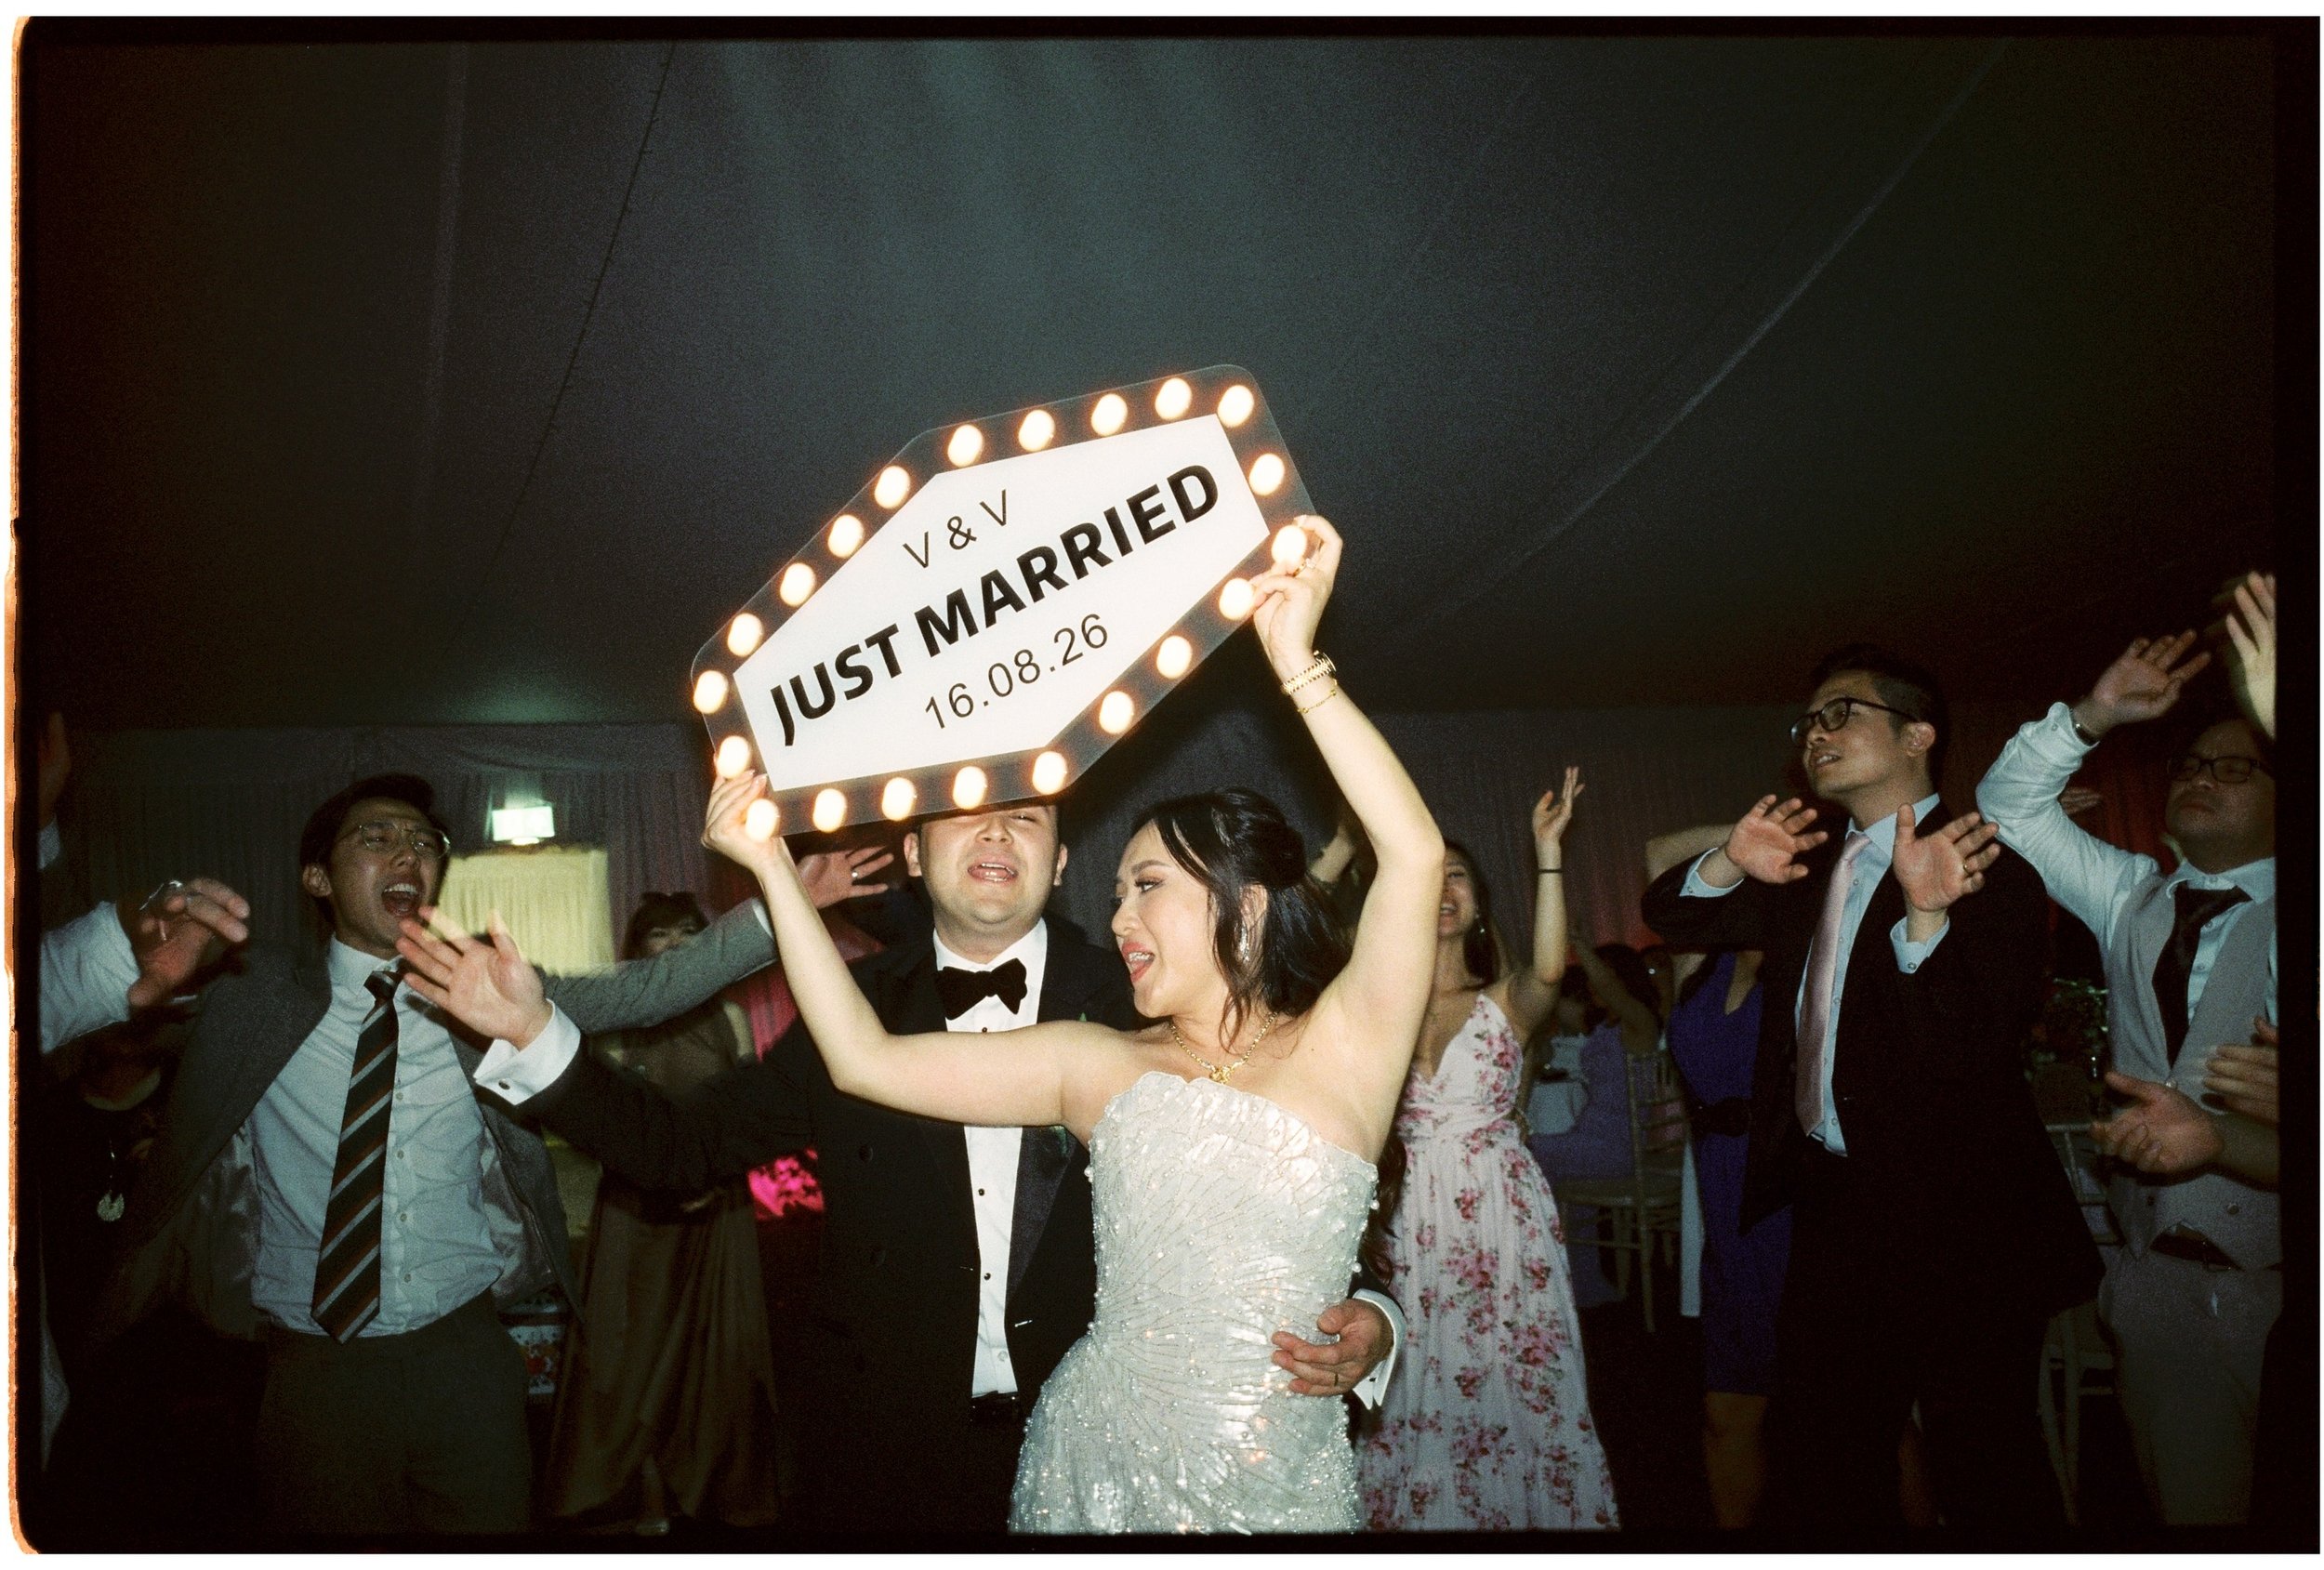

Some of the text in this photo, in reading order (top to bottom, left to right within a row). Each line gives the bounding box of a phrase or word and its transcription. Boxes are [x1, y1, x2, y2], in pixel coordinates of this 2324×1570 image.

[903, 489, 1007, 569] V & V
[770, 465, 1219, 747] JUST MARRIED
[925, 613, 1108, 729] 16.08.26
